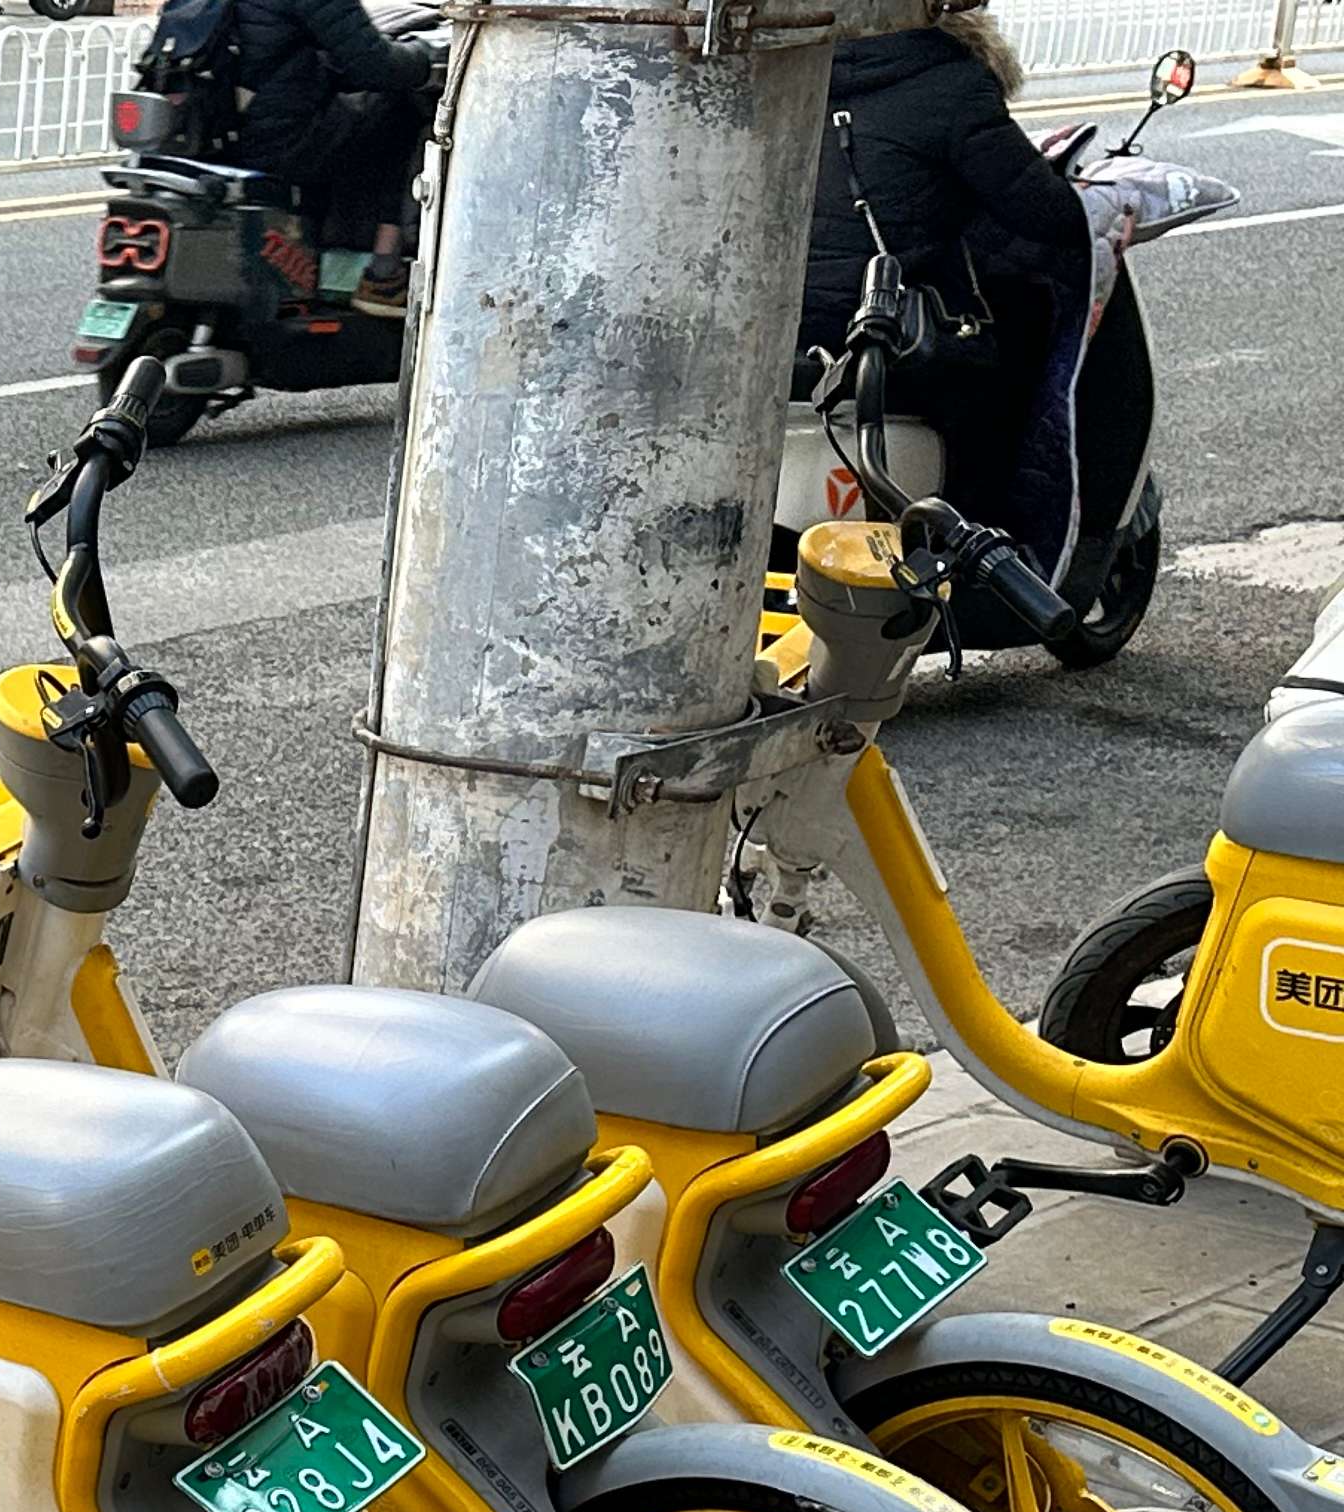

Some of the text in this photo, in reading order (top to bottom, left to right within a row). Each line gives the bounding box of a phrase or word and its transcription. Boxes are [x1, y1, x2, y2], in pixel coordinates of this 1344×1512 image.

[1275, 968, 1344, 1012] 美团
[874, 1216, 908, 1247] A
[838, 1228, 971, 1343] 277W8
[551, 1328, 665, 1456] KB089
